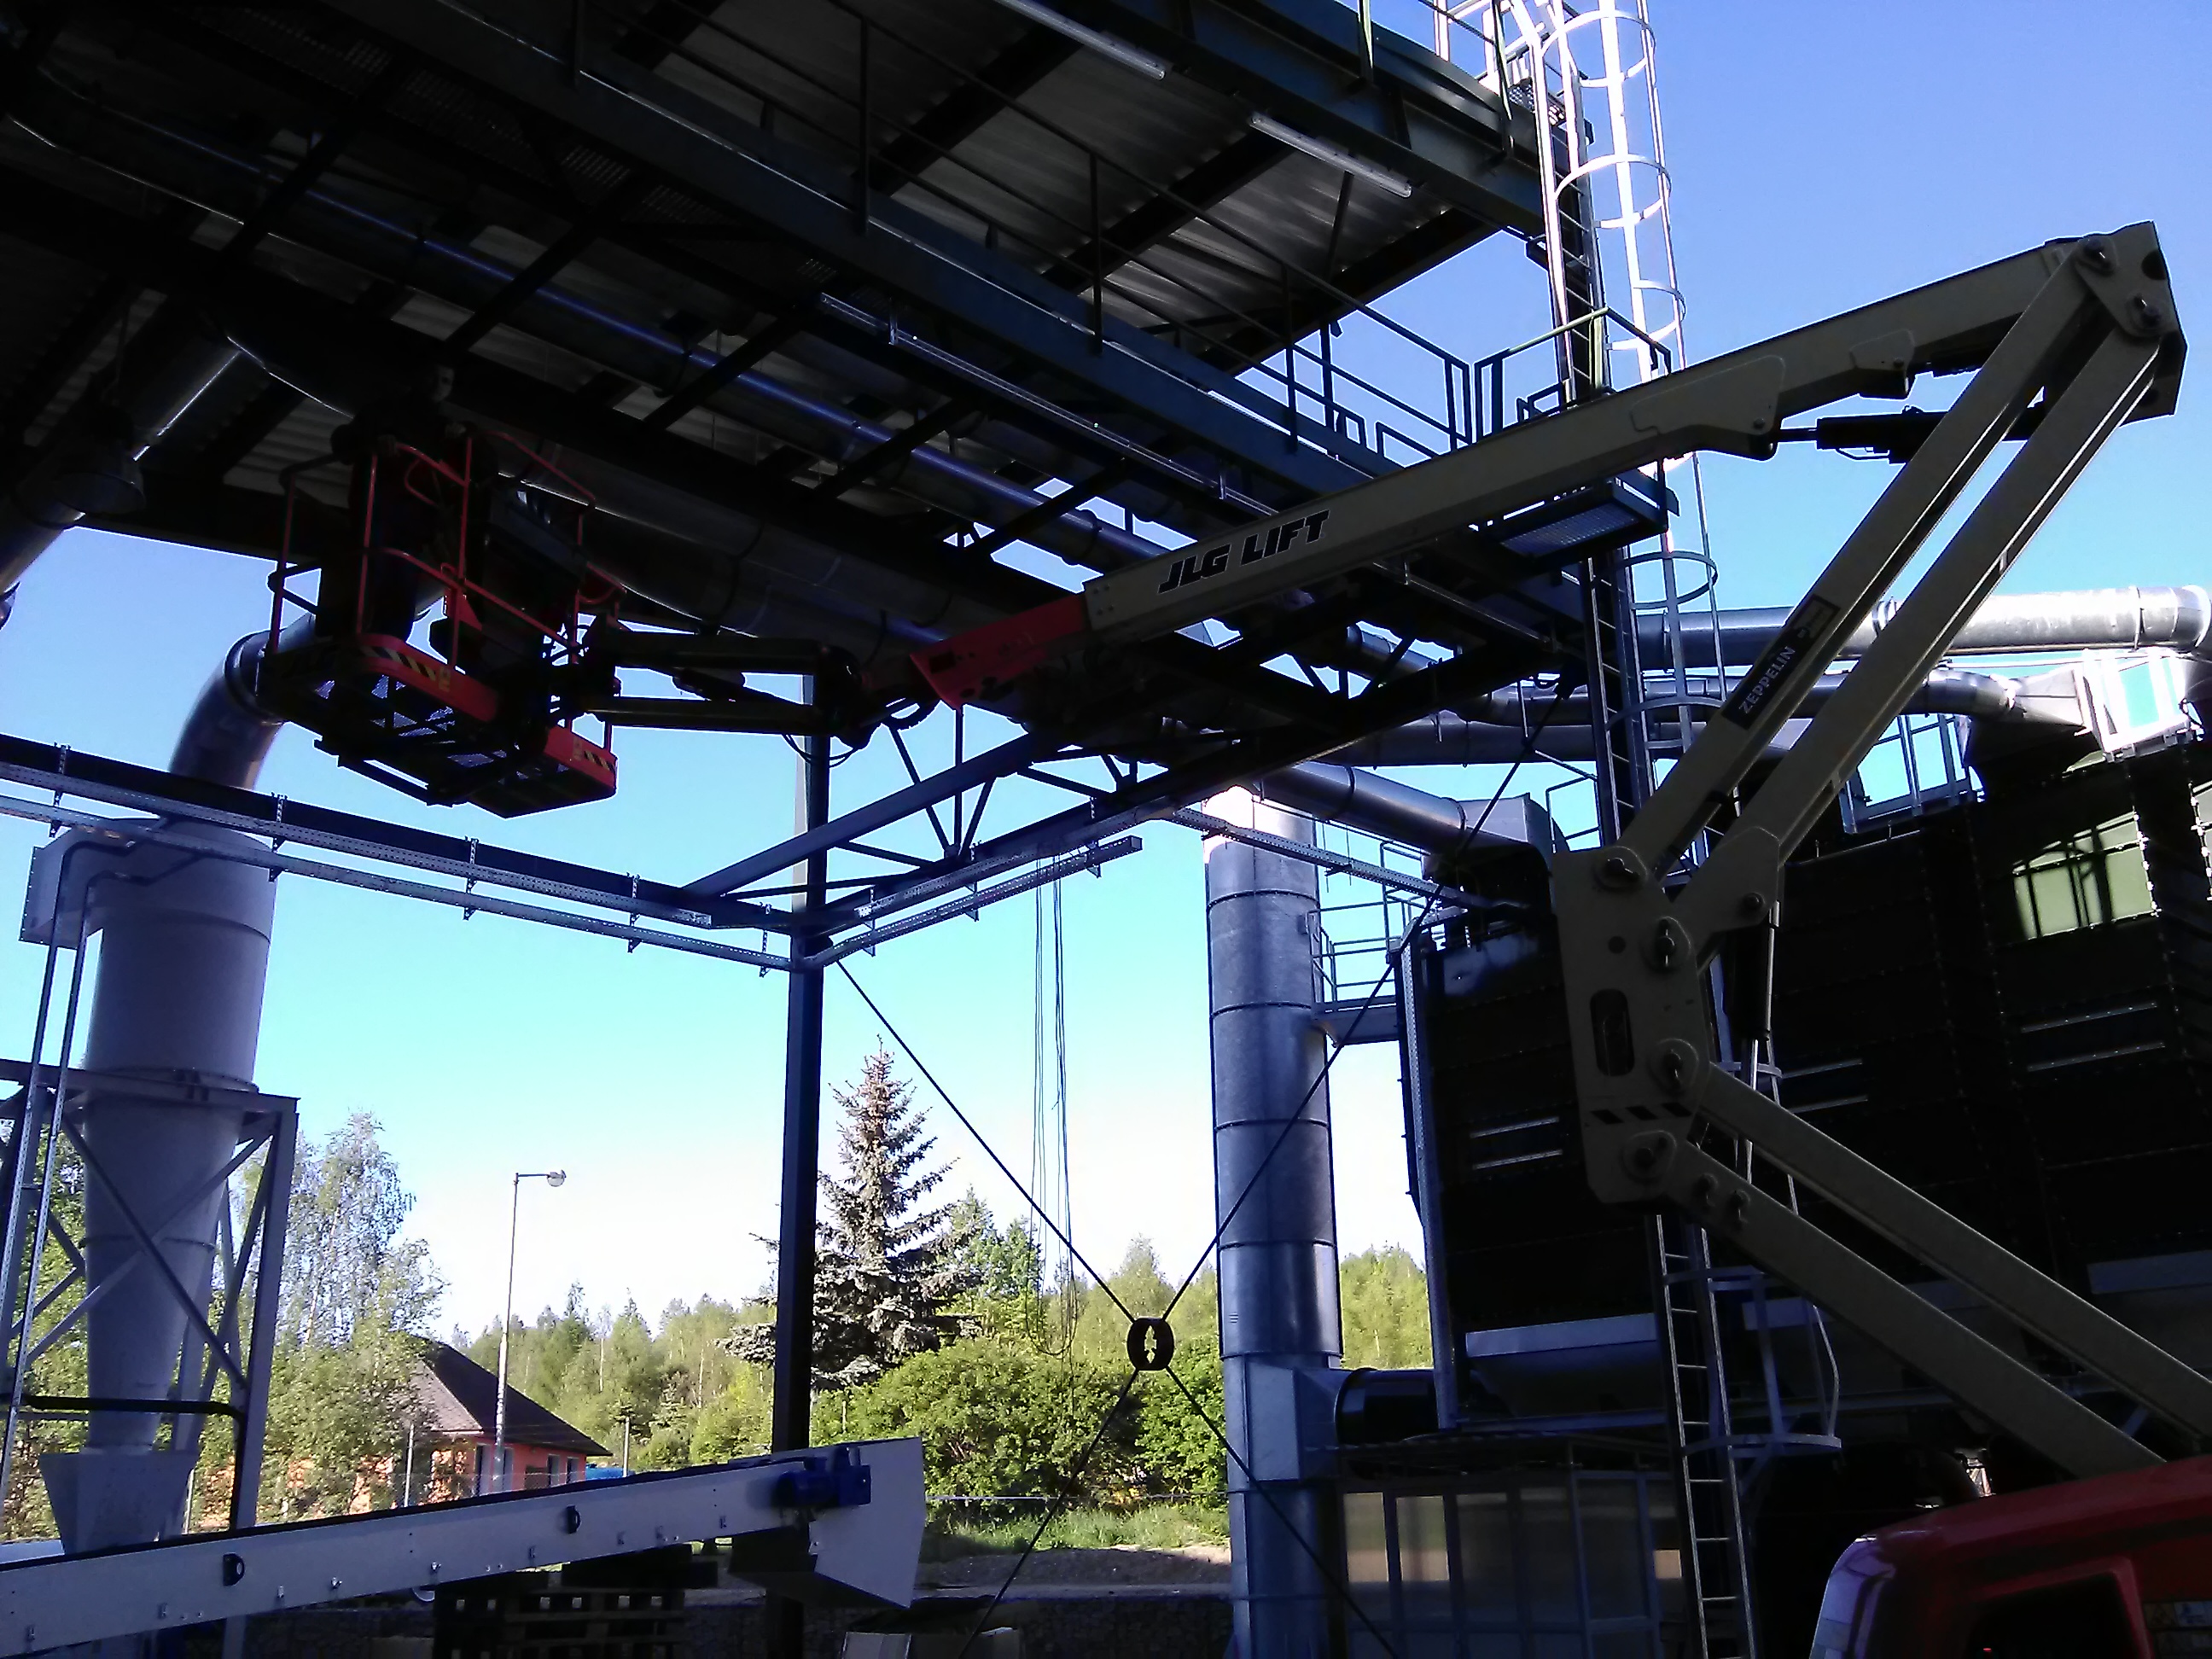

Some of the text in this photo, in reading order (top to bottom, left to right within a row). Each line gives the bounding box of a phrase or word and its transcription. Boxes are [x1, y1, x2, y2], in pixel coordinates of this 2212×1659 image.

[1157, 509, 1330, 594] JLG LIFT
[1738, 646, 1796, 714] ZEPPELIN
